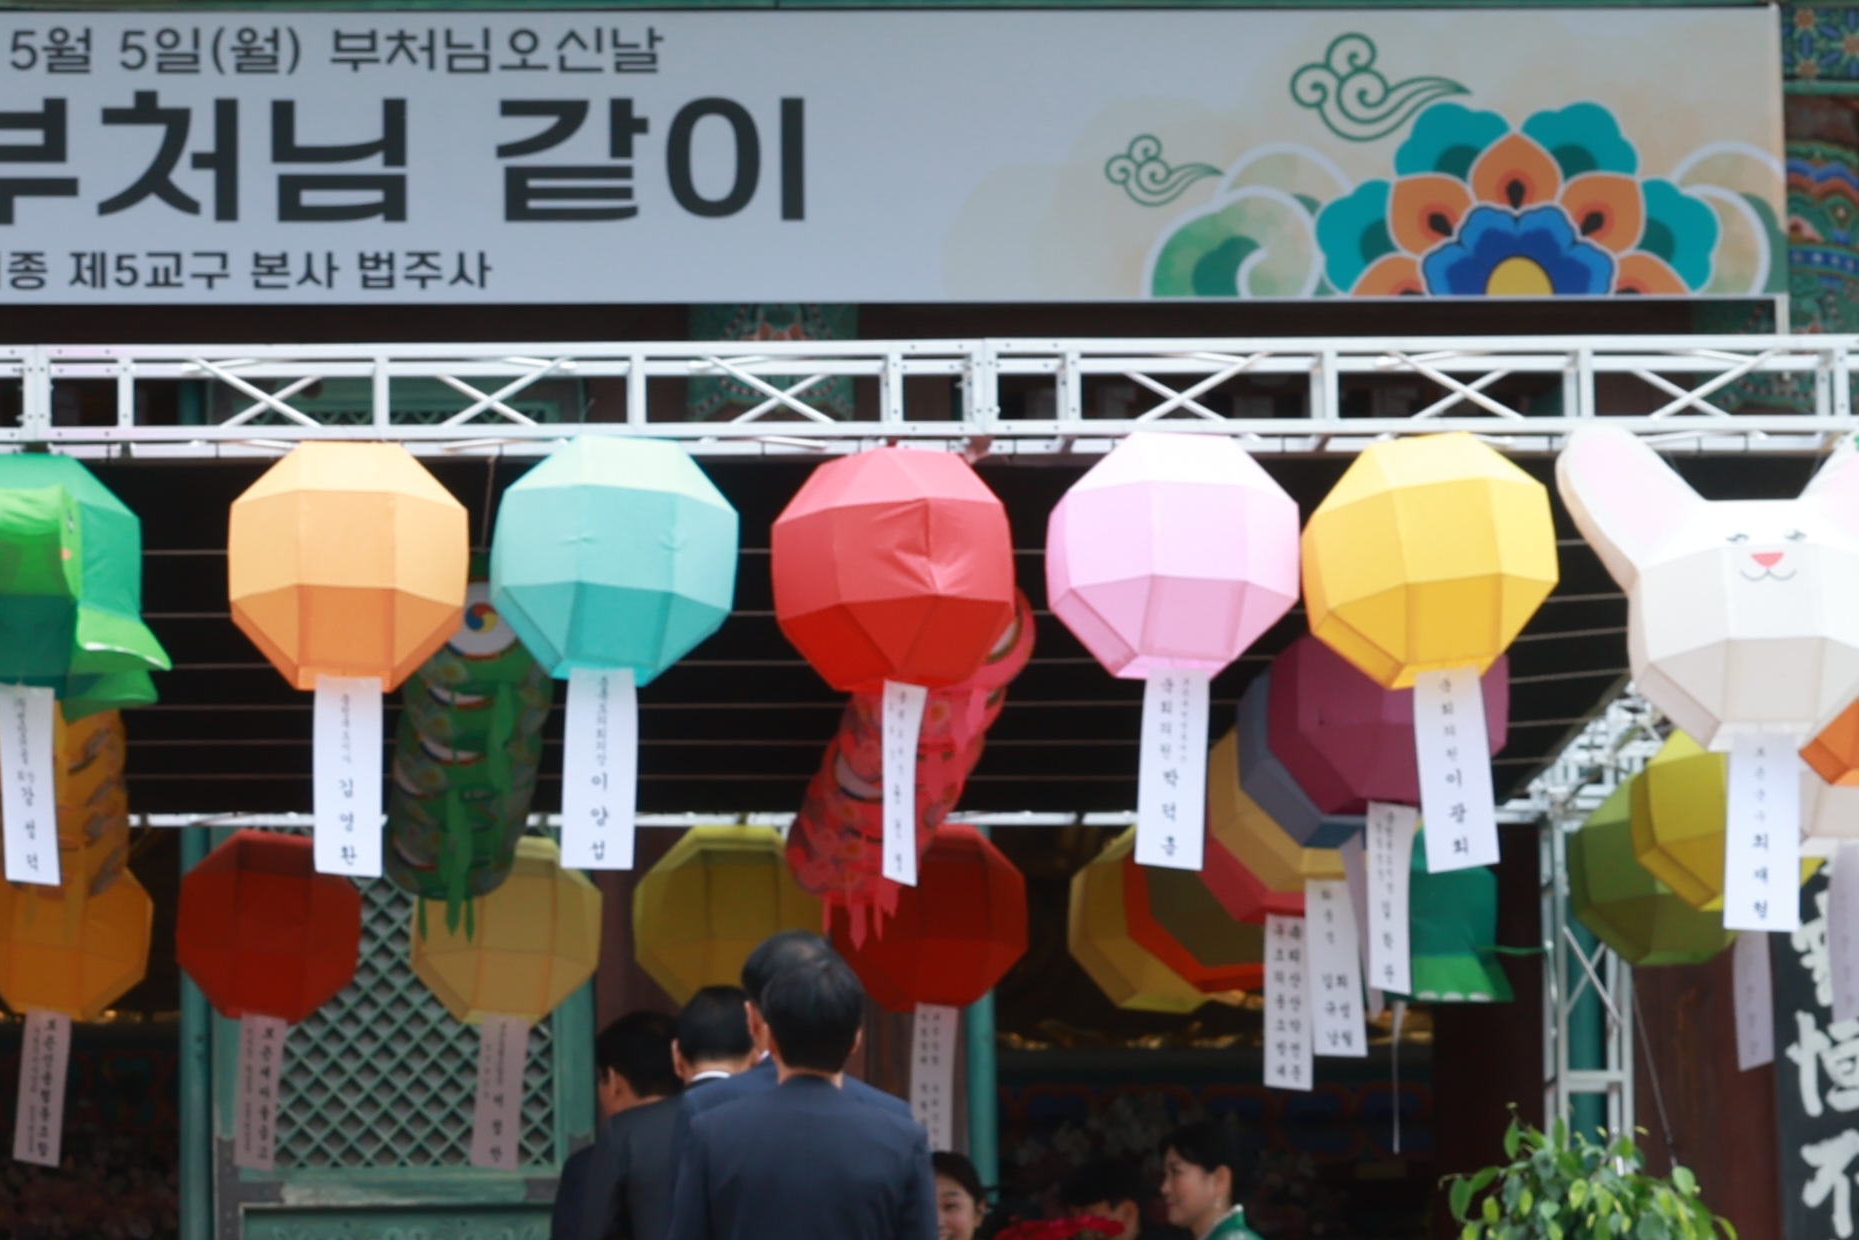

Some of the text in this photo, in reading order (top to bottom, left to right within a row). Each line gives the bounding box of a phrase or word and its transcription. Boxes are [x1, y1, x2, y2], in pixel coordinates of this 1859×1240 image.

[10, 27, 92, 74] 5월
[120, 27, 301, 75] 5일(월)
[330, 27, 664, 74] 부처님오신날
[496, 97, 805, 222] 같이
[69, 251, 230, 290] 제5교구
[251, 252, 339, 289] 본사
[358, 251, 492, 290] 법주사
